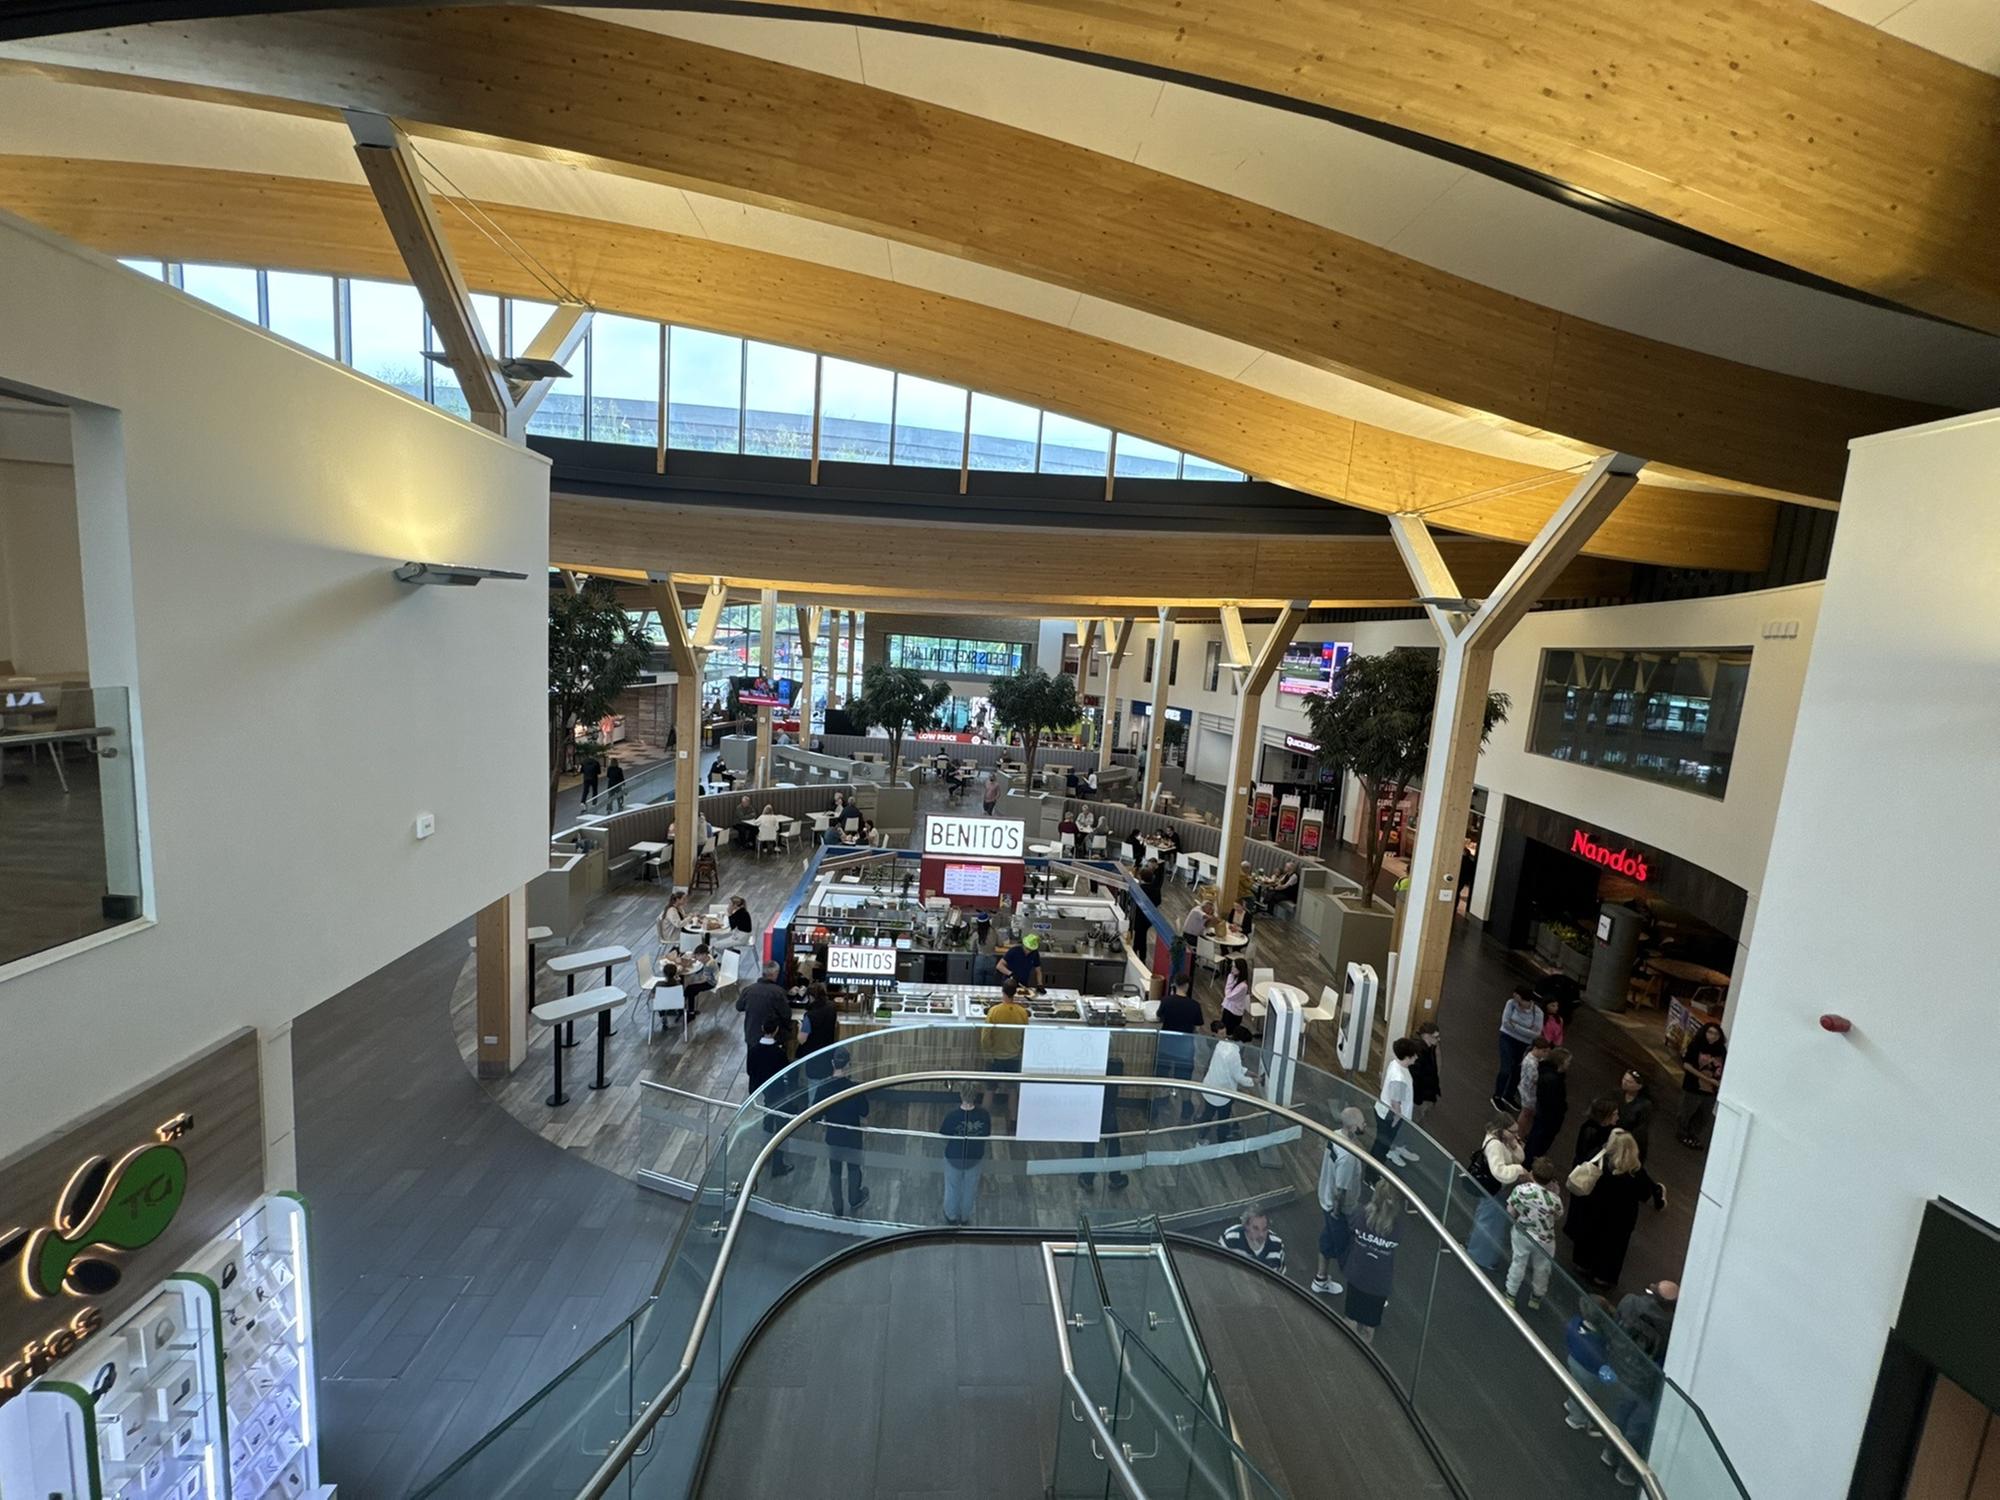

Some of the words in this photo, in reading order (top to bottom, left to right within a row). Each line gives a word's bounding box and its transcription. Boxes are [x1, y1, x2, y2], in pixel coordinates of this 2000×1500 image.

[919, 733, 937, 741] LOW
[937, 734, 957, 742] PRICE
[931, 822, 1019, 850] BENITO'S
[1571, 829, 1647, 881] Nando's
[831, 951, 893, 970] BENITO'S
